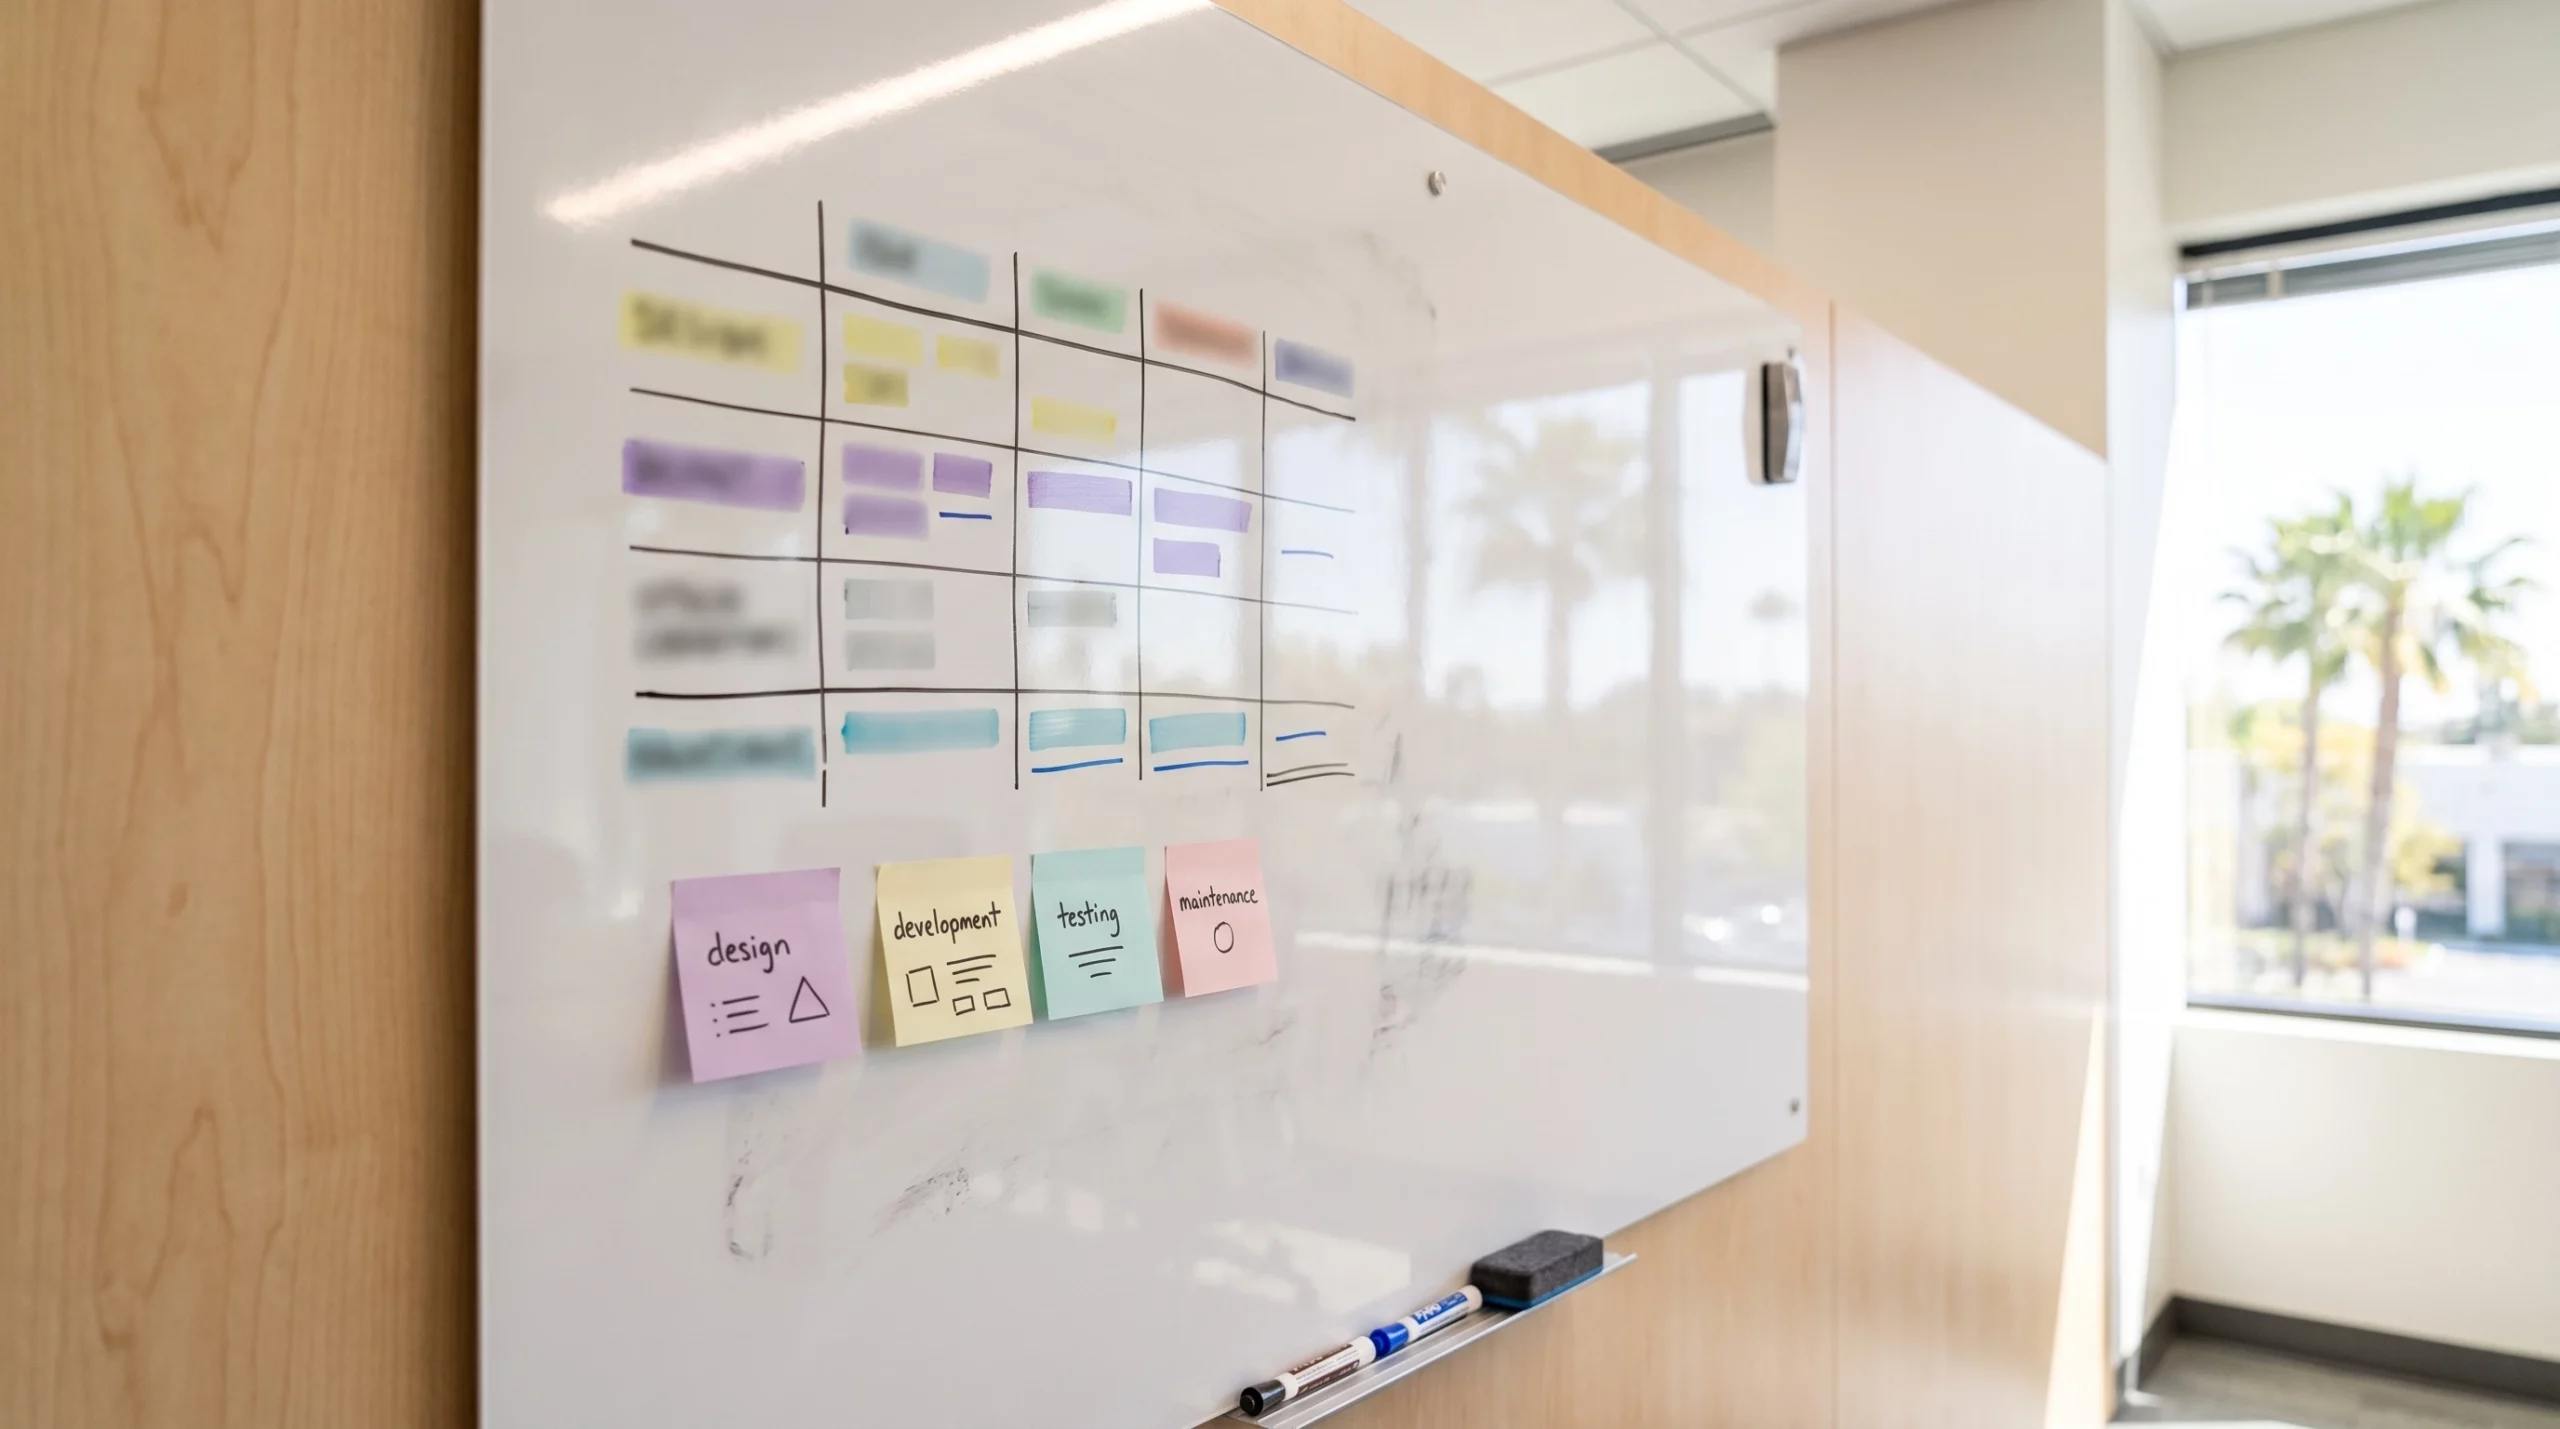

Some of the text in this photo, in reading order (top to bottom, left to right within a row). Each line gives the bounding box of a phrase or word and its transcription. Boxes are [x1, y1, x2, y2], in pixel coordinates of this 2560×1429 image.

[1179, 885, 1259, 912] maintenance
[893, 900, 1002, 945] development
[1056, 900, 1121, 938] testing
[707, 931, 791, 974] design
